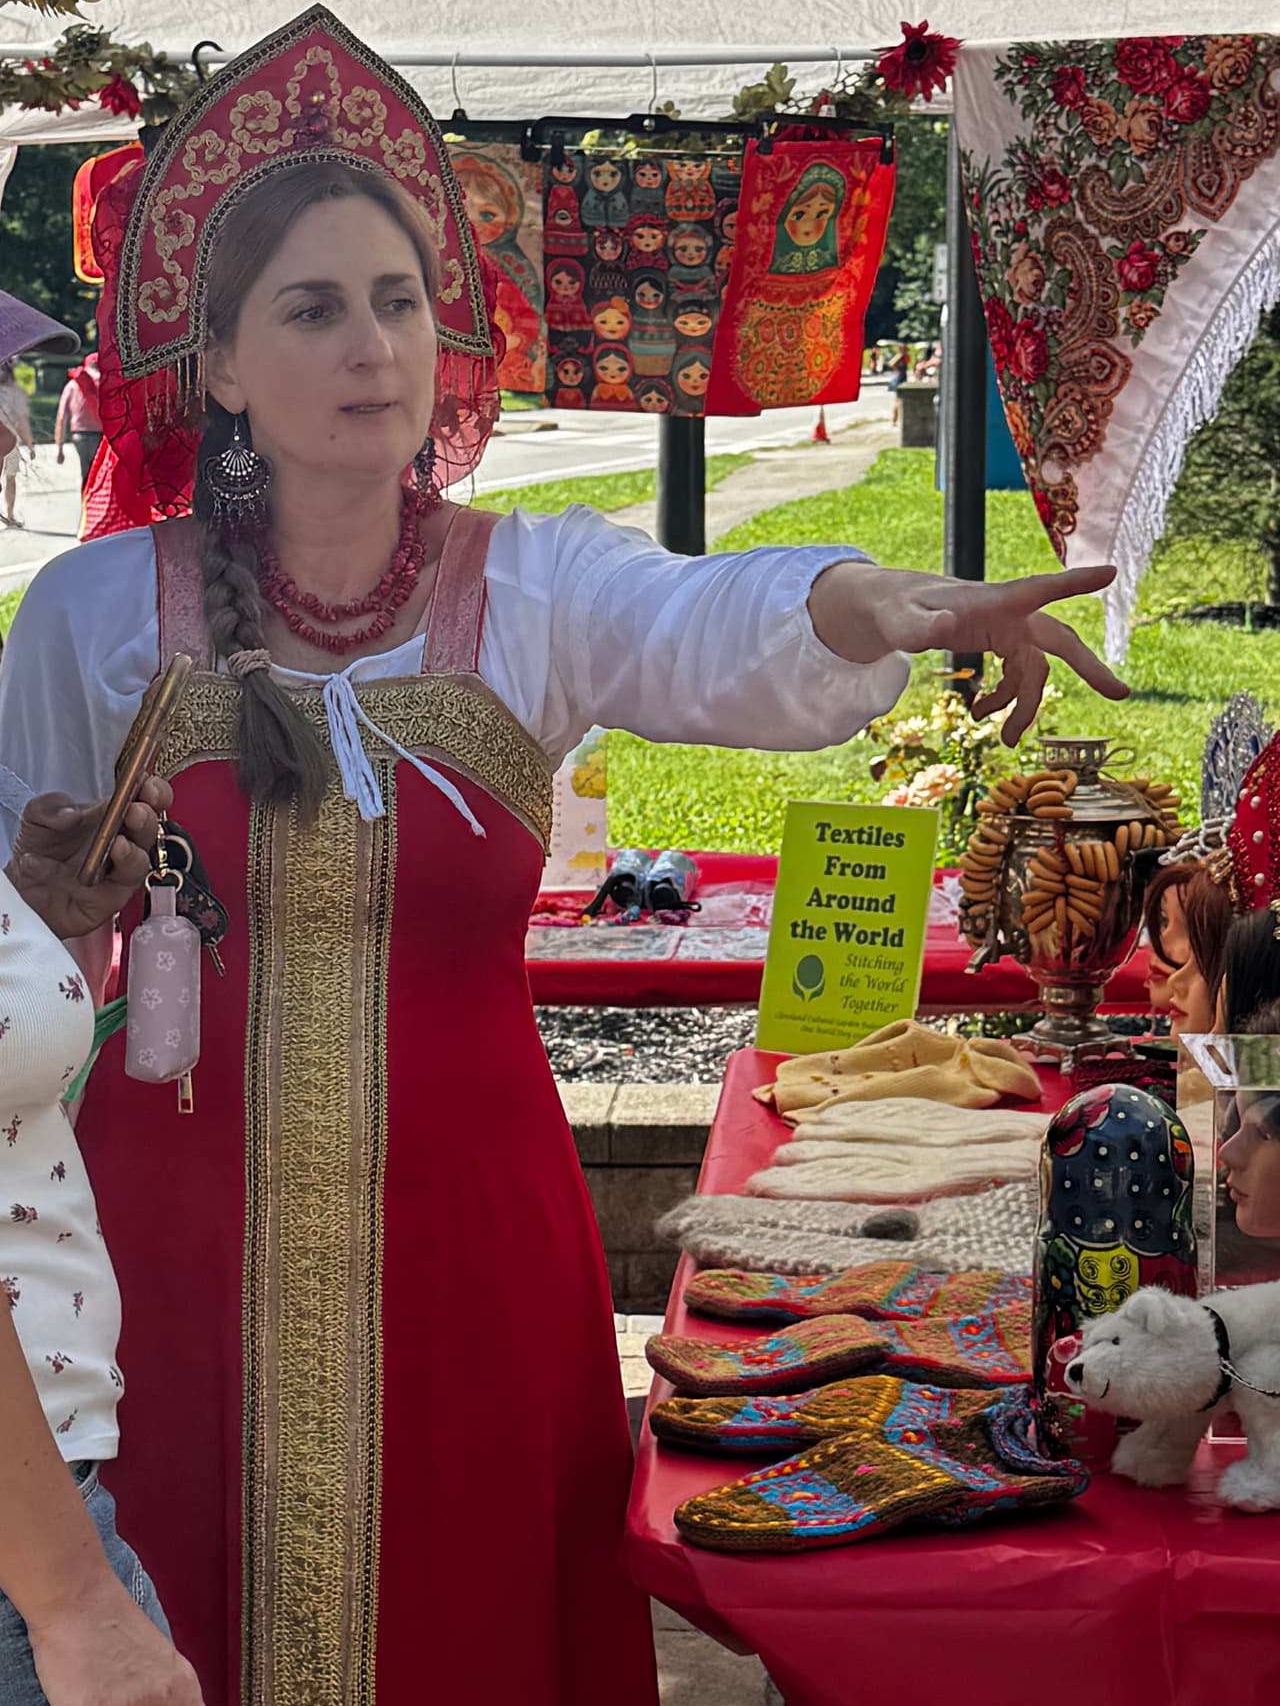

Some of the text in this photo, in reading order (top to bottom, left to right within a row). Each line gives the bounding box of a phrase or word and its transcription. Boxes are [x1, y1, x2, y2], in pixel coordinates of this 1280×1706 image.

[815, 822, 905, 848] Textiles
[824, 855, 886, 880] From
[806, 887, 895, 914] Around
[790, 919, 904, 948] the World
[845, 953, 905, 975] Stitching
[839, 973, 908, 993] the World
[841, 995, 898, 1014] Together
